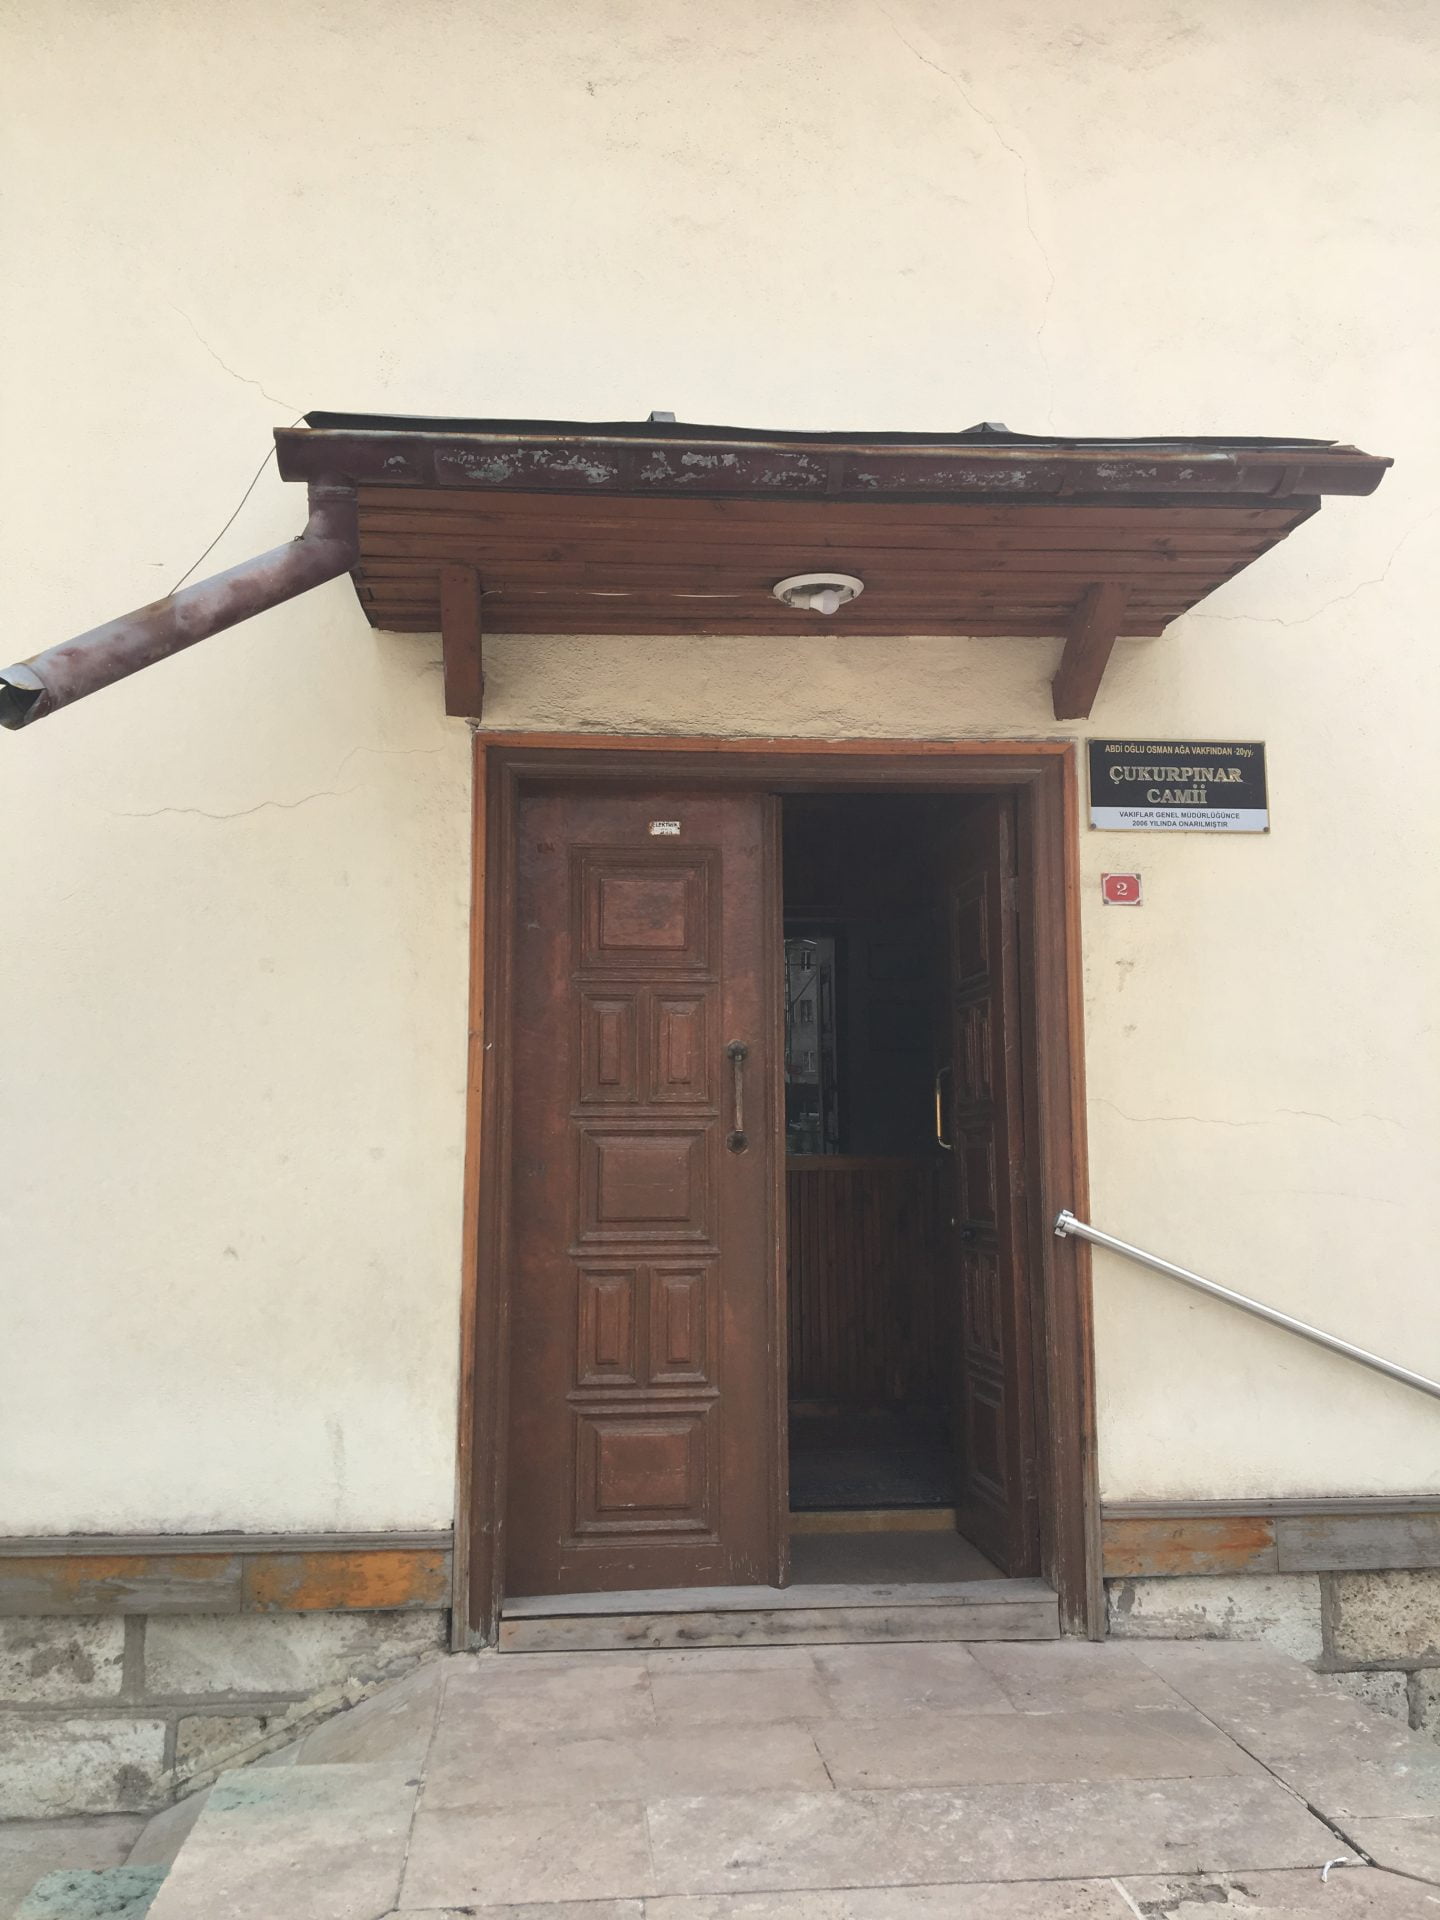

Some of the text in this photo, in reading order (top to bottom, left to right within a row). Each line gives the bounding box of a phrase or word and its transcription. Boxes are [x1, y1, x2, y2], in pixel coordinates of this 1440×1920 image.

[1124, 743, 1145, 754] OĞLU
[1146, 746, 1173, 754] OSMAN
[1174, 744, 1191, 754] AĞA
[1191, 746, 1233, 755] VAKFINDAN
[1109, 765, 1243, 784] ÇUKURPINAR
[1146, 784, 1208, 804] CAMİİ
[1116, 882, 1128, 896] 2
